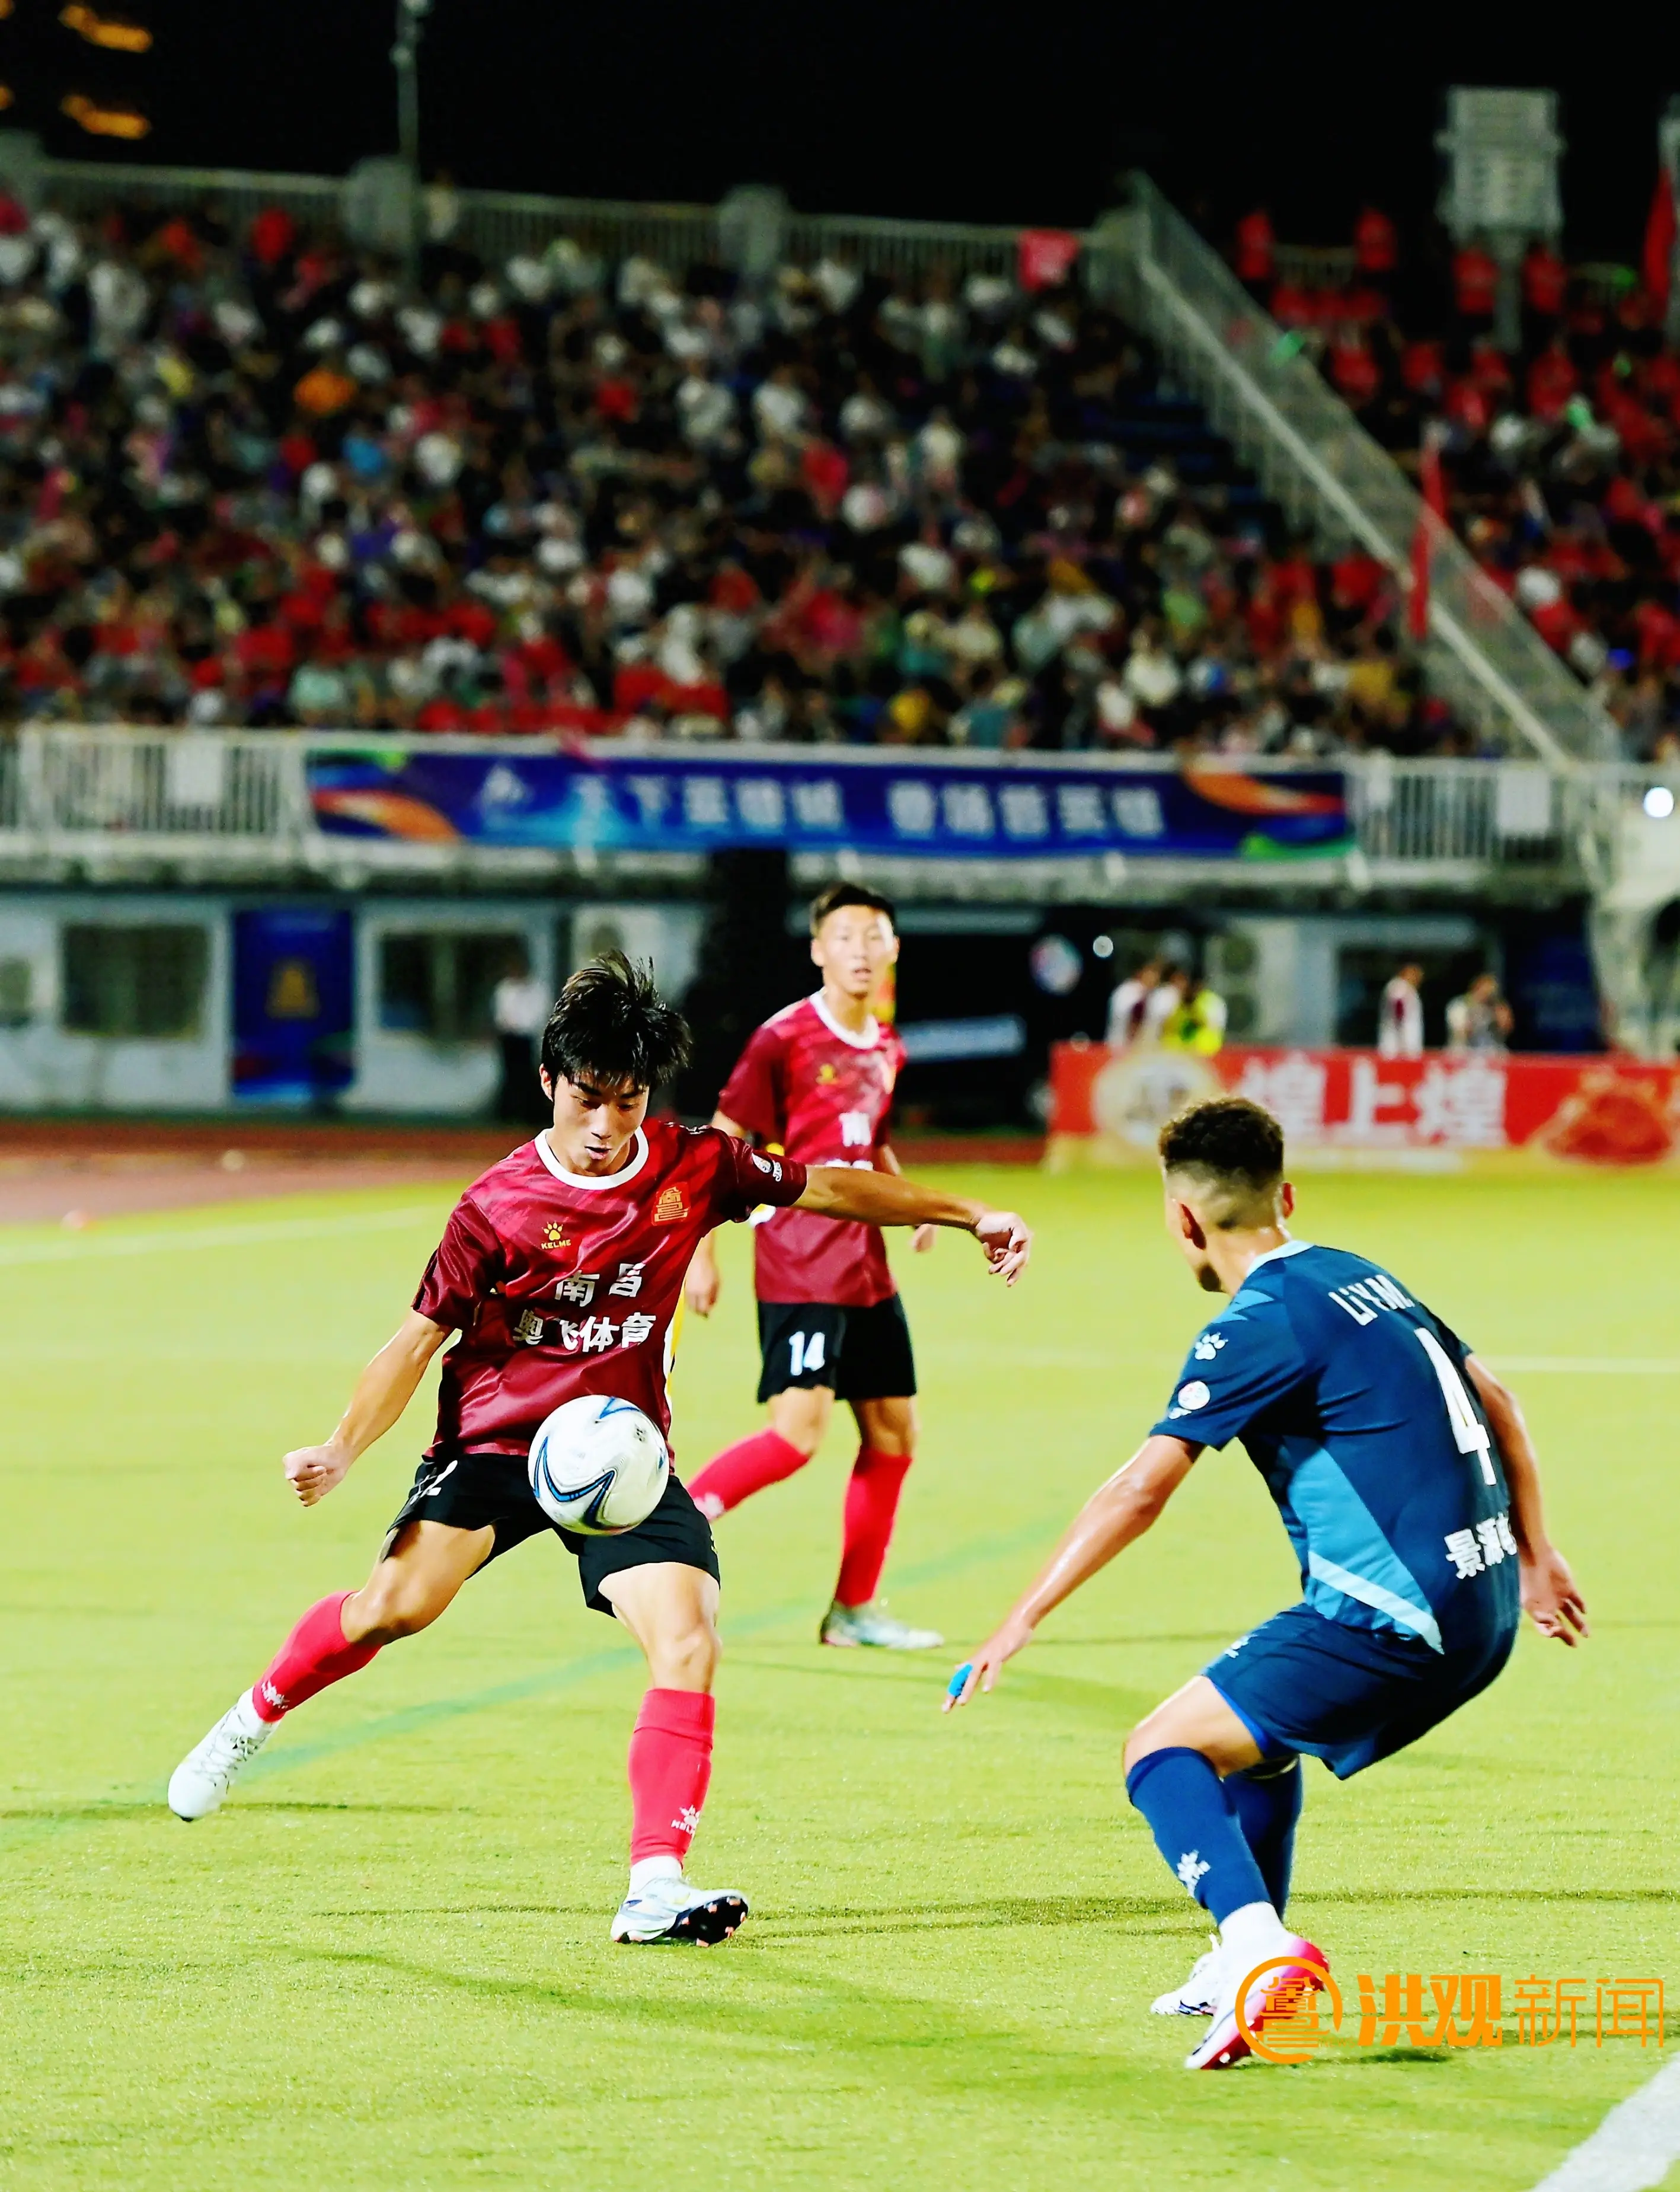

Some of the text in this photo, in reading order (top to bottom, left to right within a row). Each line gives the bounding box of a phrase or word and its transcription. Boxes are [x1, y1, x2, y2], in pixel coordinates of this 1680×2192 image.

[541, 1239, 571, 1250] KELME
[554, 1263, 646, 1307] 南昌
[513, 1309, 656, 1352] 奥飞体育
[788, 1330, 826, 1376] 14
[1413, 1327, 1497, 1485] 4
